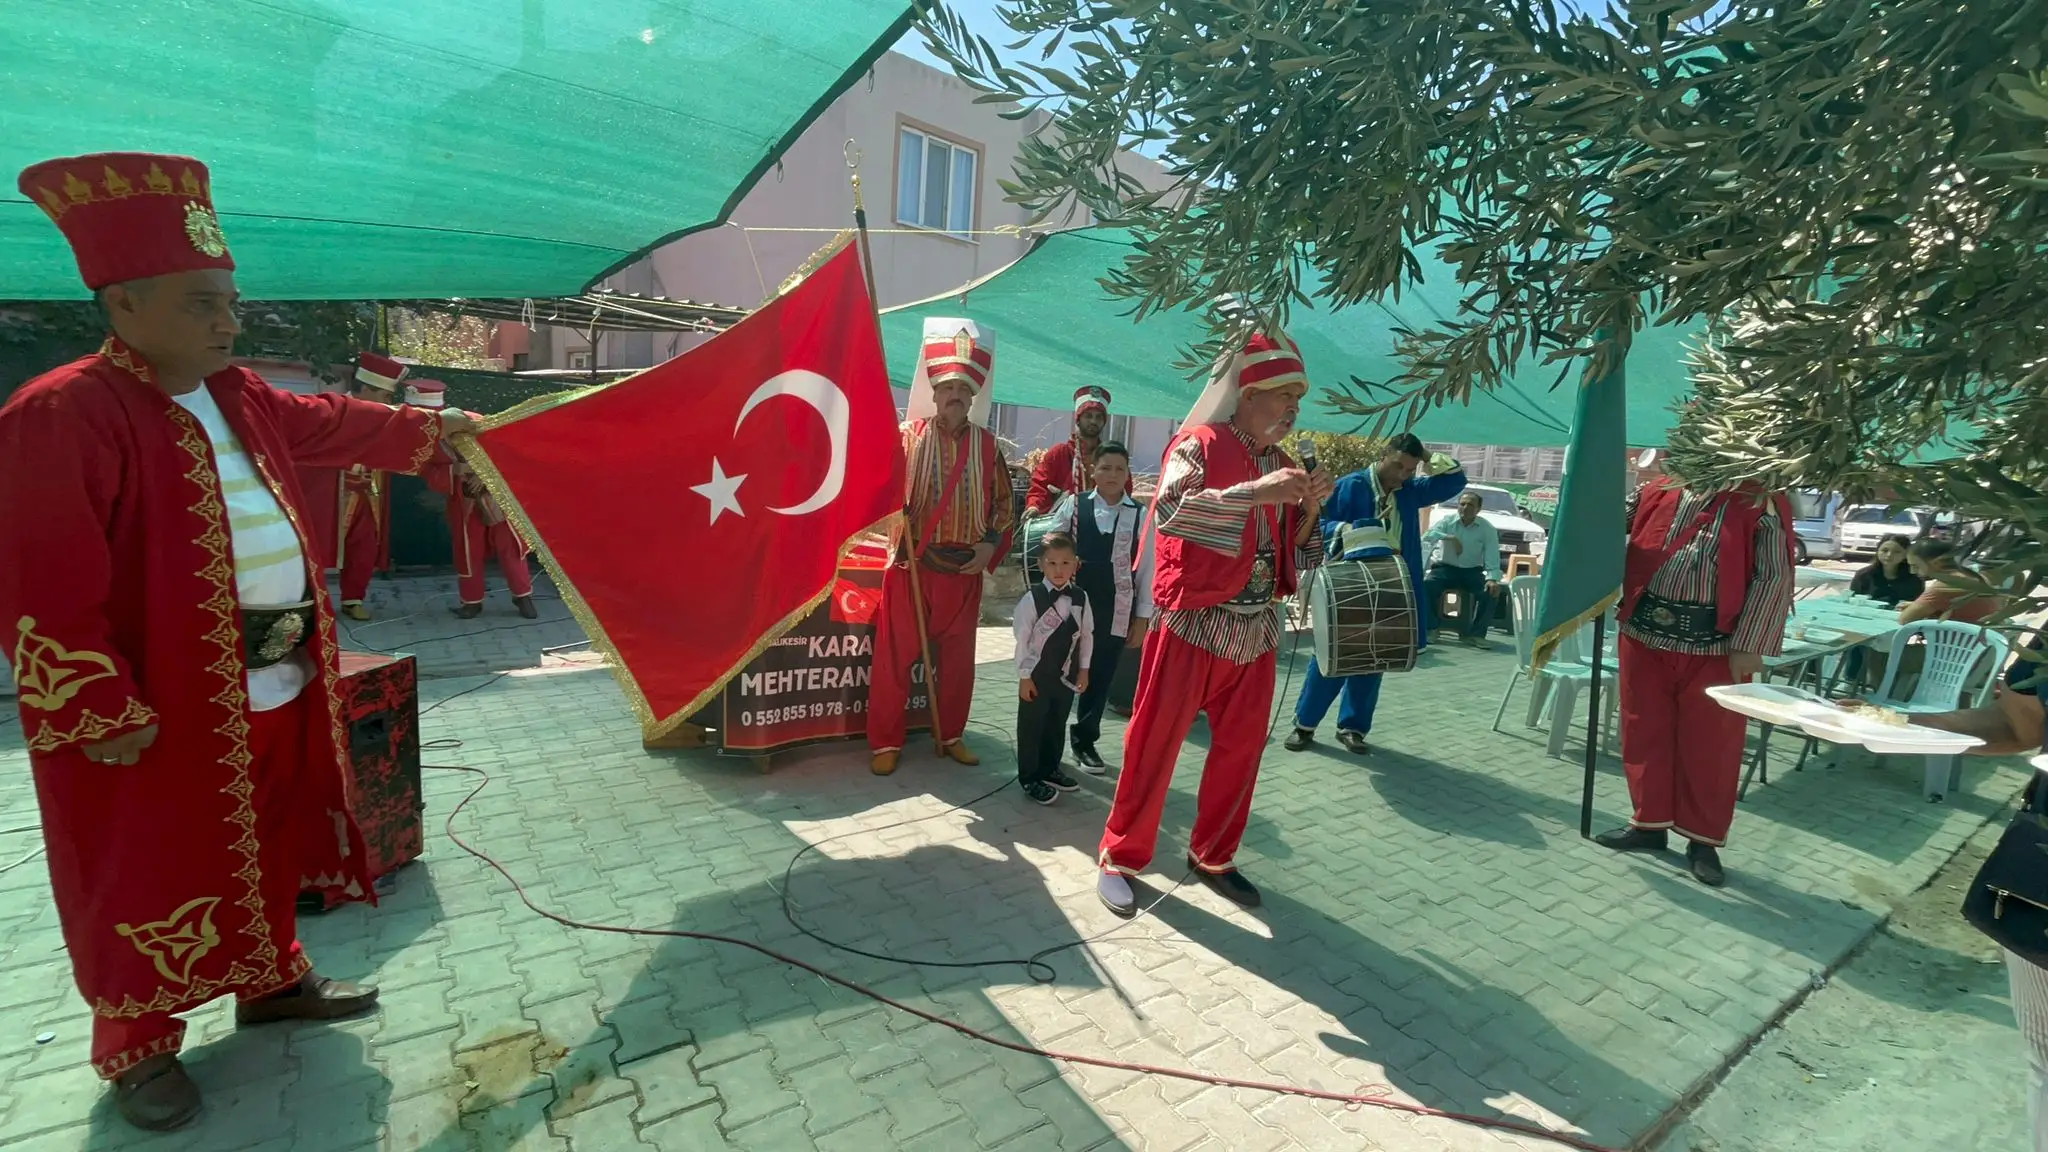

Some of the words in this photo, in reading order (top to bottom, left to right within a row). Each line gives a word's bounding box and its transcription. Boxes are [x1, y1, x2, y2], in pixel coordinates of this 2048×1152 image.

[808, 634, 873, 658] KARA
[741, 665, 873, 696] MEHTERAN
[741, 711, 752, 727] 0
[756, 708, 781, 726] 552
[783, 704, 807, 722] 855
[809, 702, 824, 717] 19
[826, 701, 843, 716] 78
[853, 700, 862, 714] 0
[912, 695, 927, 709] 95
